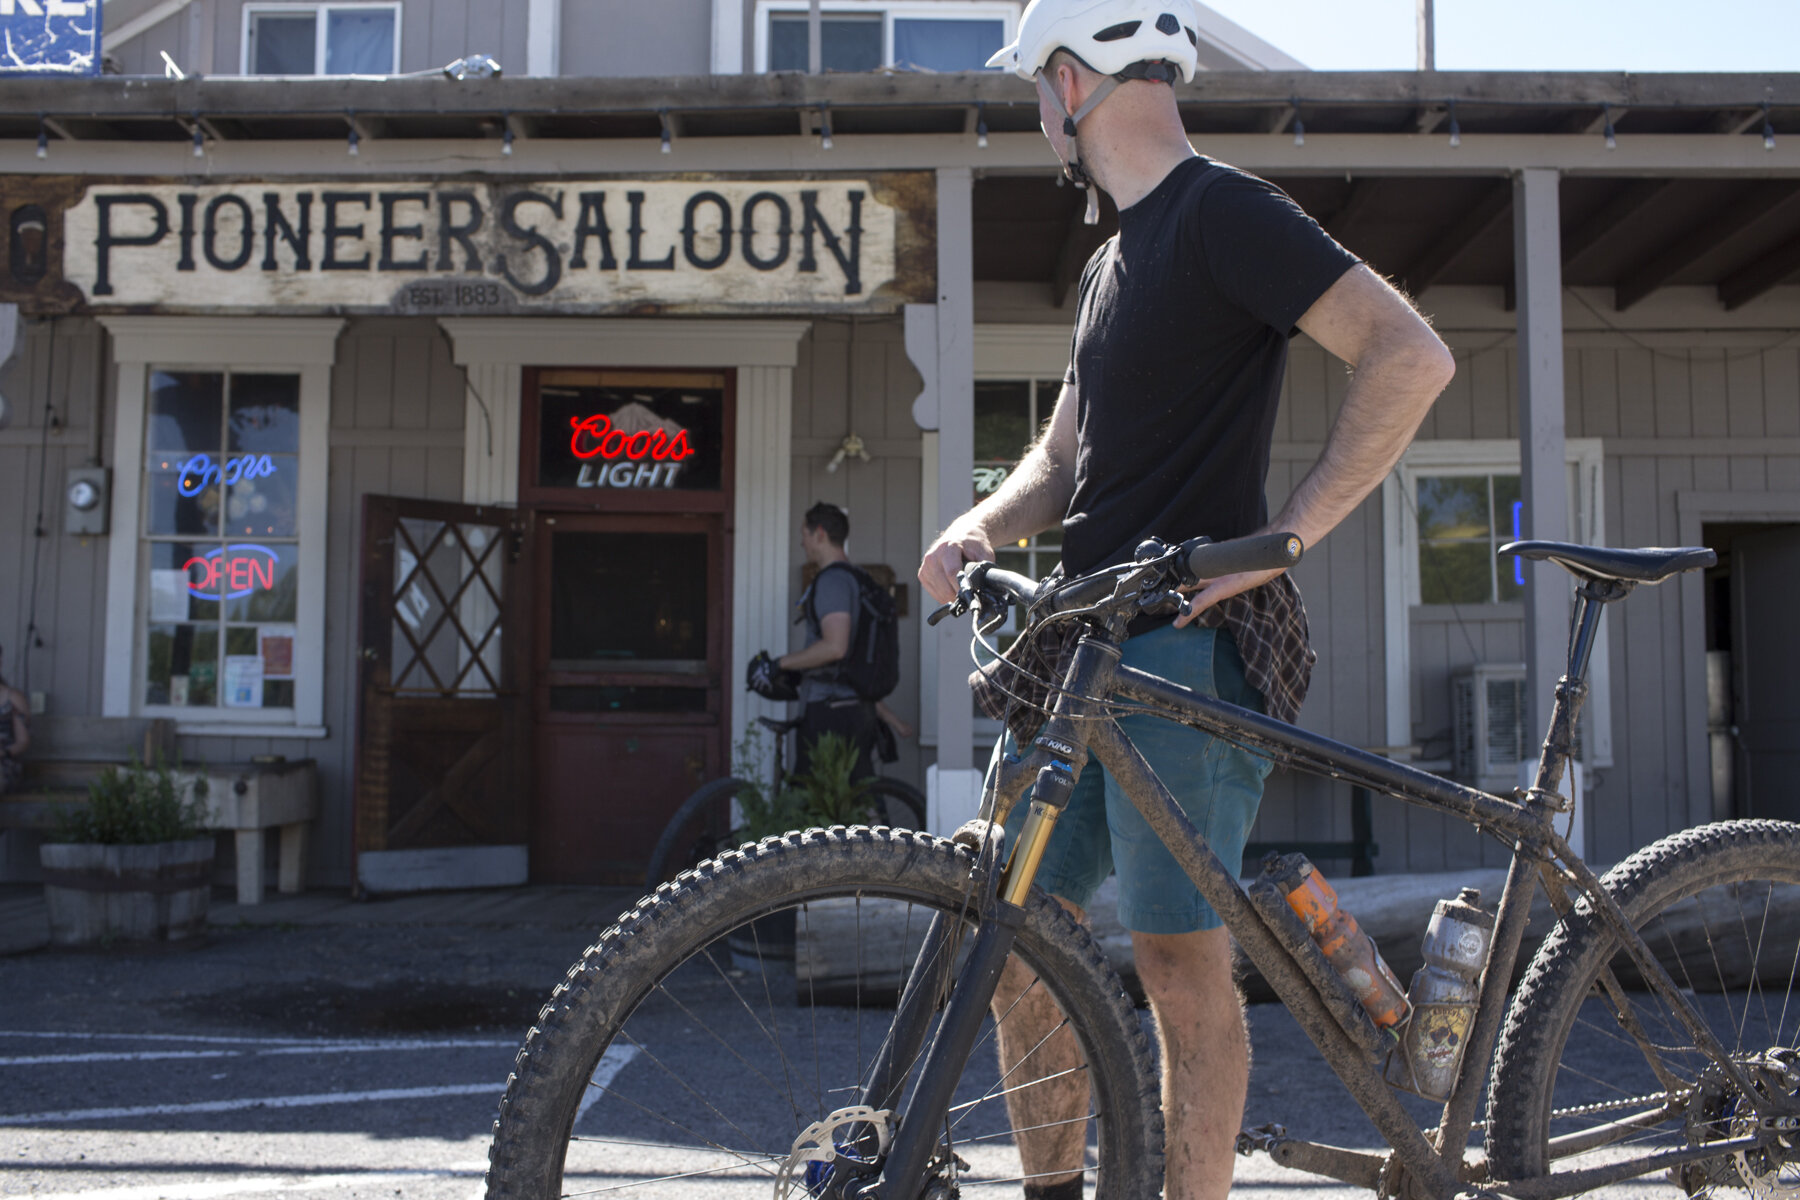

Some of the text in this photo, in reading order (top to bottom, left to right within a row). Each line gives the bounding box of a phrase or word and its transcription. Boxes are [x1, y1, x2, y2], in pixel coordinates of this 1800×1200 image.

[93, 190, 865, 296] PIONEER SALOON
[455, 284, 500, 307] 1883
[570, 413, 695, 461] Coors
[176, 453, 278, 498] Coors
[576, 461, 682, 488] LIGHT
[182, 556, 274, 590] OPEN
[1047, 740, 1073, 754] KING
